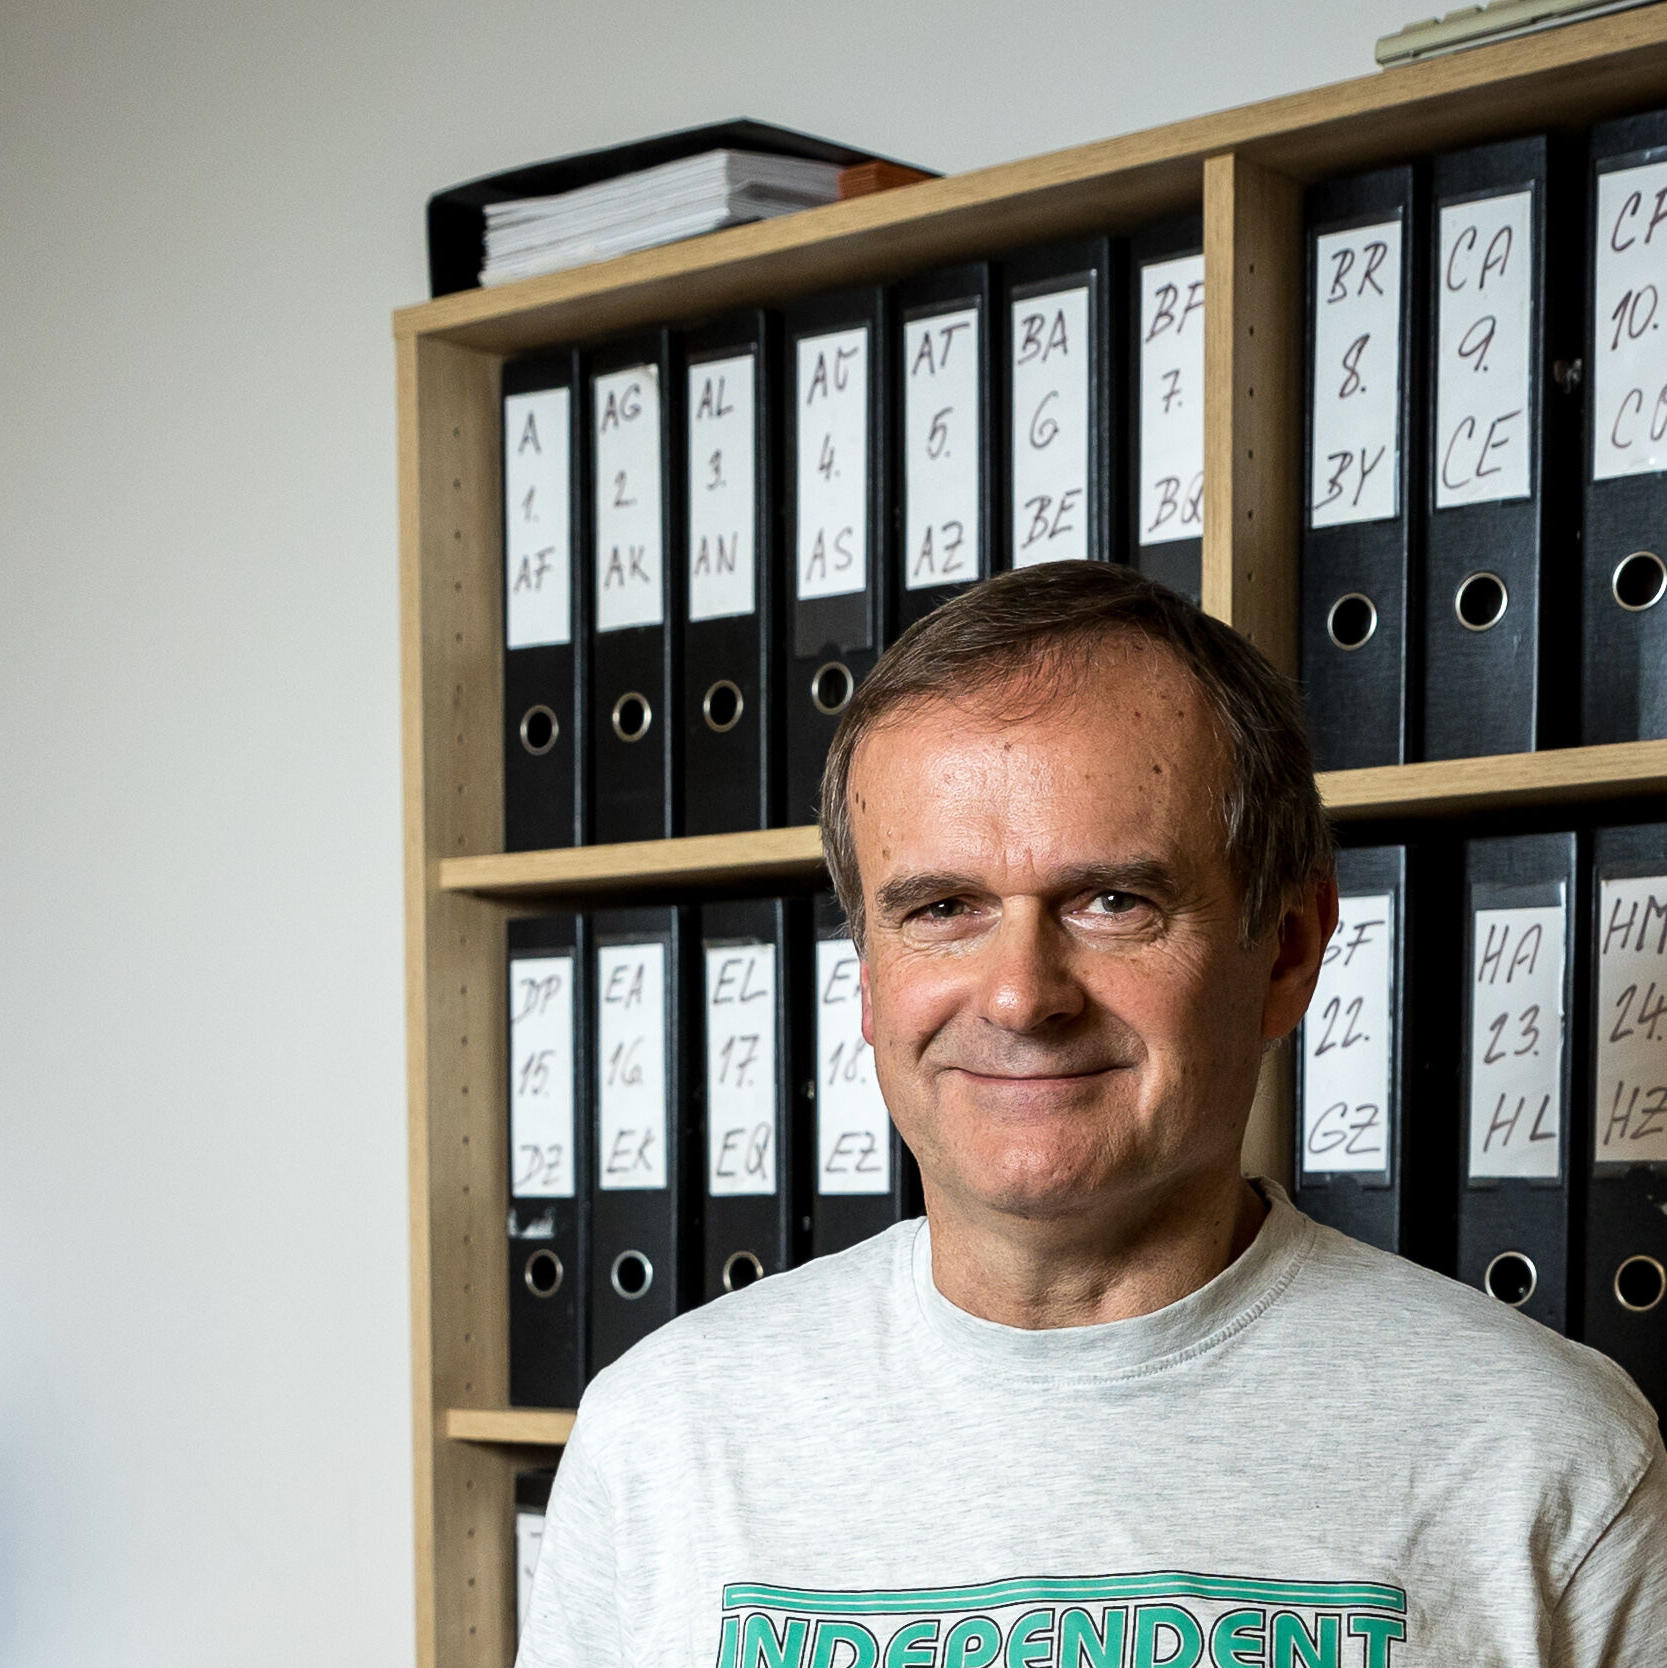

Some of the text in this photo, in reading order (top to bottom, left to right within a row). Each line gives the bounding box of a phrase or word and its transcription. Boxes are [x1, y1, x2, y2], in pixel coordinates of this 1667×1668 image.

[1326, 242, 1389, 304] BR
[1446, 225, 1514, 293] CA
[1144, 280, 1204, 344] BF
[1610, 284, 1658, 351] 10.
[912, 322, 969, 376] AT
[1018, 312, 1069, 366] BA
[1339, 332, 1371, 399] 8.
[1459, 315, 1496, 373] 9.
[602, 386, 641, 431] AG
[697, 378, 733, 420] AL
[1162, 369, 1183, 412] 7.
[518, 411, 542, 455] A
[818, 432, 840, 479] 4.
[927, 408, 952, 459] 5.
[1441, 410, 1522, 490] CE
[1314, 446, 1385, 510] BY
[1021, 489, 1083, 550] BE
[513, 546, 555, 592] AF
[605, 547, 651, 589] AK
[693, 533, 738, 576] AN
[806, 529, 854, 582] AS
[914, 522, 965, 578] AZ
[1478, 923, 1543, 984] HA
[604, 964, 645, 1008] EA
[712, 957, 767, 1006] EL
[822, 959, 861, 1006] E
[1314, 997, 1370, 1058] 22.
[1483, 1005, 1540, 1065] 23.
[719, 1034, 760, 1087] 17.
[1308, 1102, 1381, 1155] GZ
[1483, 1093, 1556, 1153] HL
[606, 1128, 655, 1174] EK
[716, 1121, 773, 1182] EQ
[824, 1131, 882, 1174] EZ
